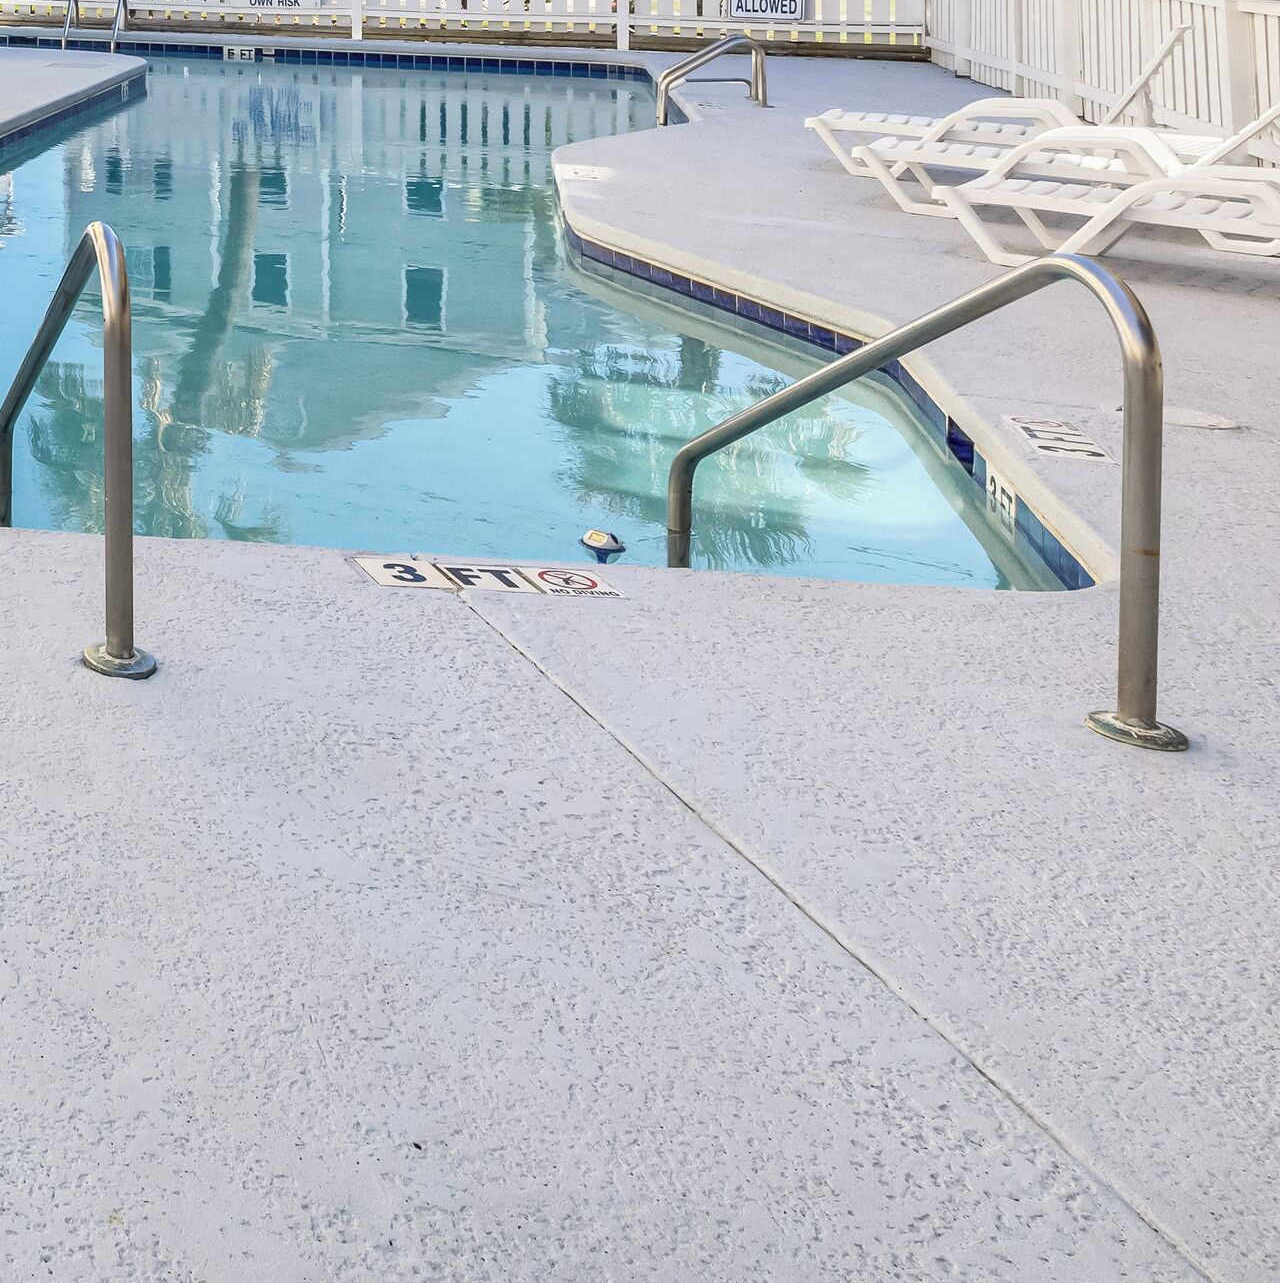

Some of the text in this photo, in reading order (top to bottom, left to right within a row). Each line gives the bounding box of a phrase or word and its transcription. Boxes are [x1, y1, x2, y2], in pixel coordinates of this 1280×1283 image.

[382, 563, 520, 588] 3 FT
[549, 588, 621, 597] NO DIVING
